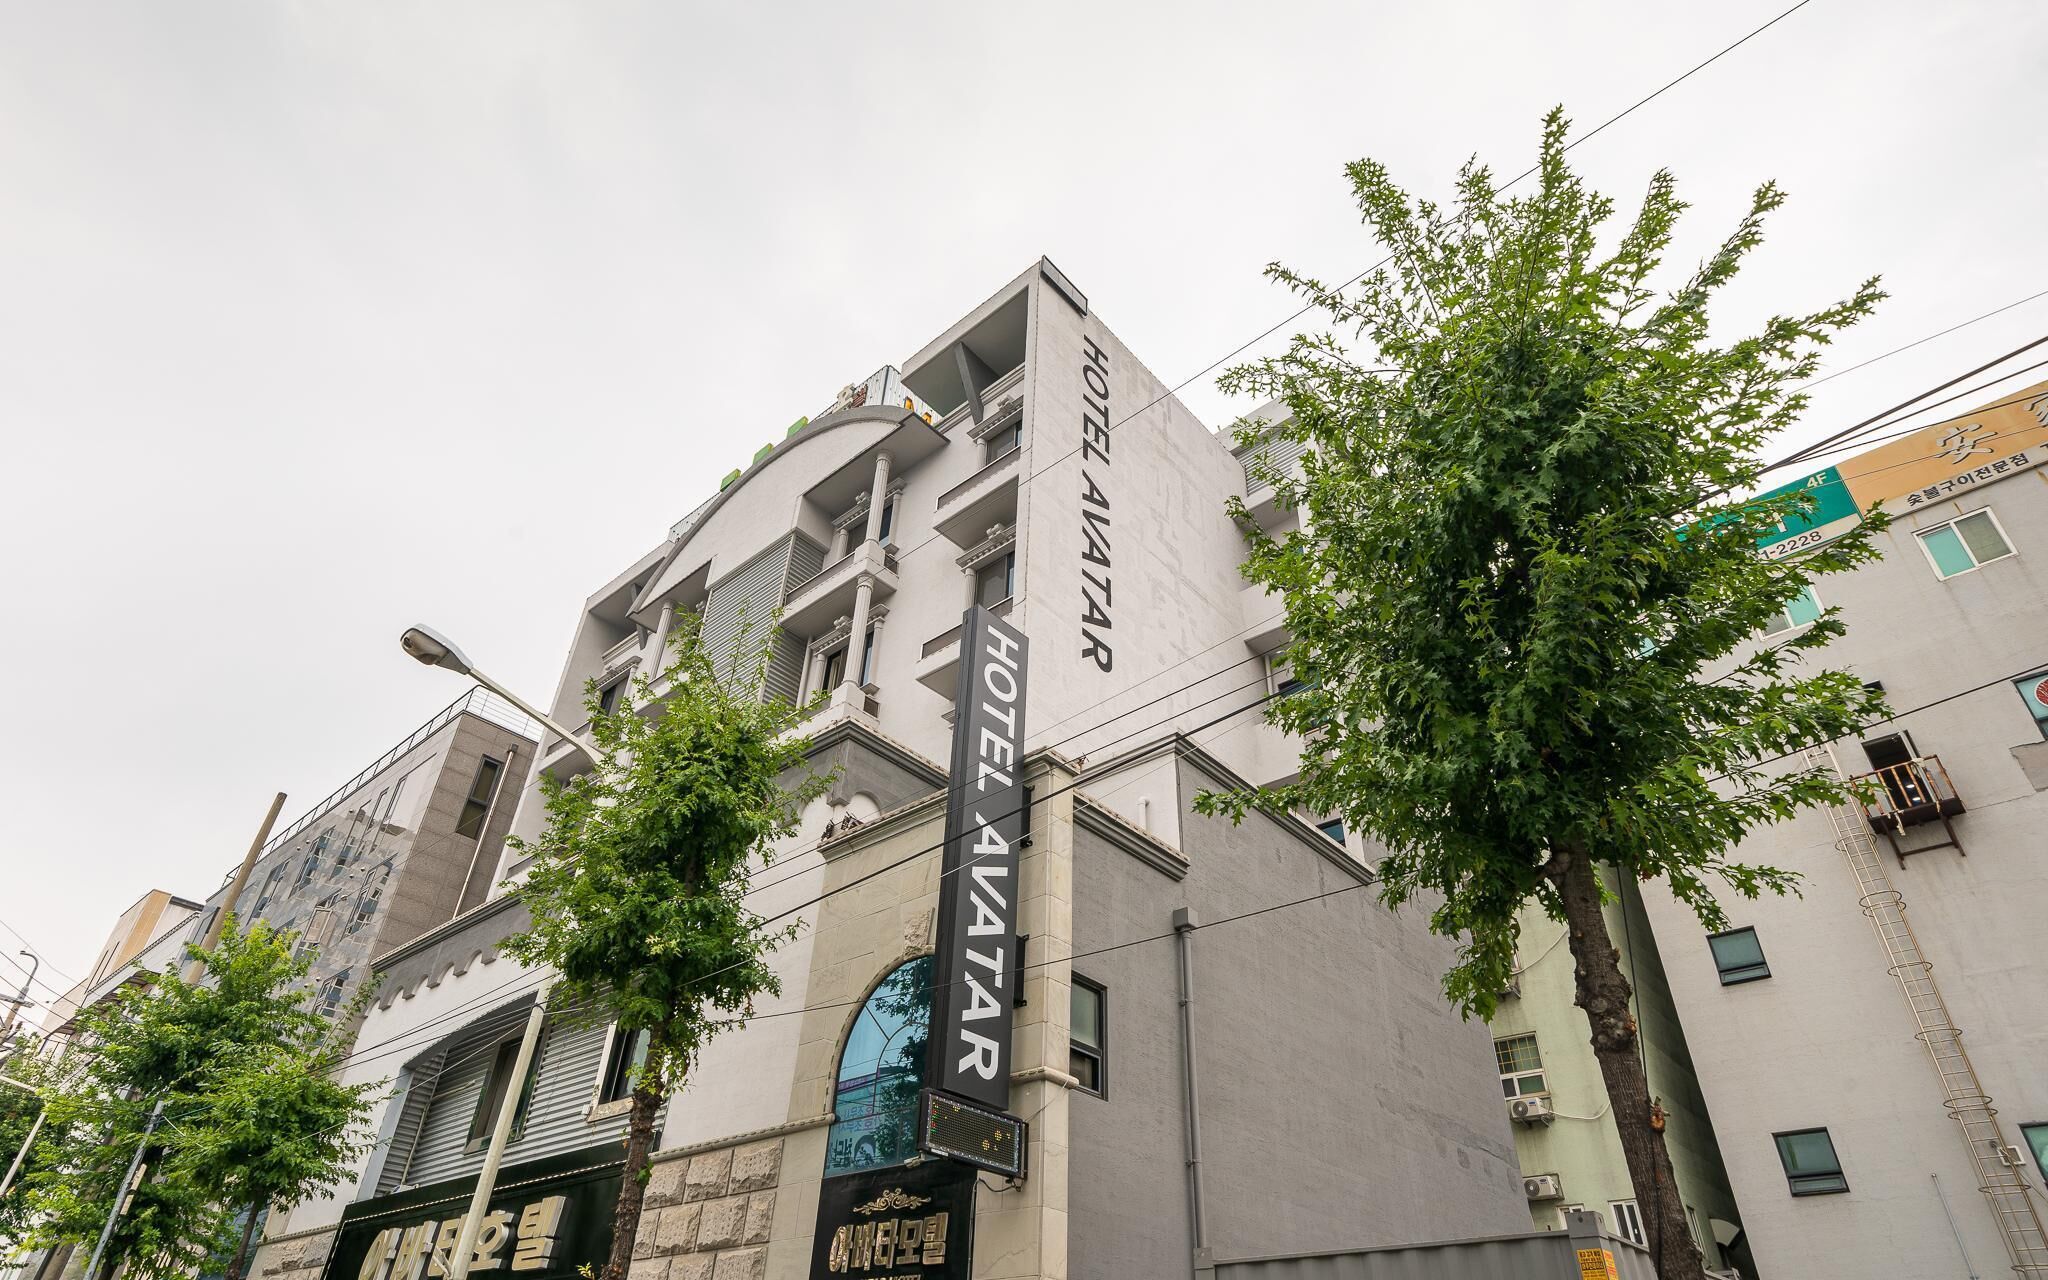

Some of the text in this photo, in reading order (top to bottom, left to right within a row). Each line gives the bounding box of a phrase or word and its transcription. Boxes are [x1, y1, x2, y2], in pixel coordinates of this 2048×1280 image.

[1081, 334, 1113, 673] HOTEL AVATAR
[1806, 472, 1828, 488] 4F
[1907, 453, 2029, 506] 숯불구이전문점
[1757, 531, 1823, 560] 1-2228
[957, 624, 1019, 1082] HOTEL AVATAR
[829, 1212, 949, 1273] 아바타모텔
